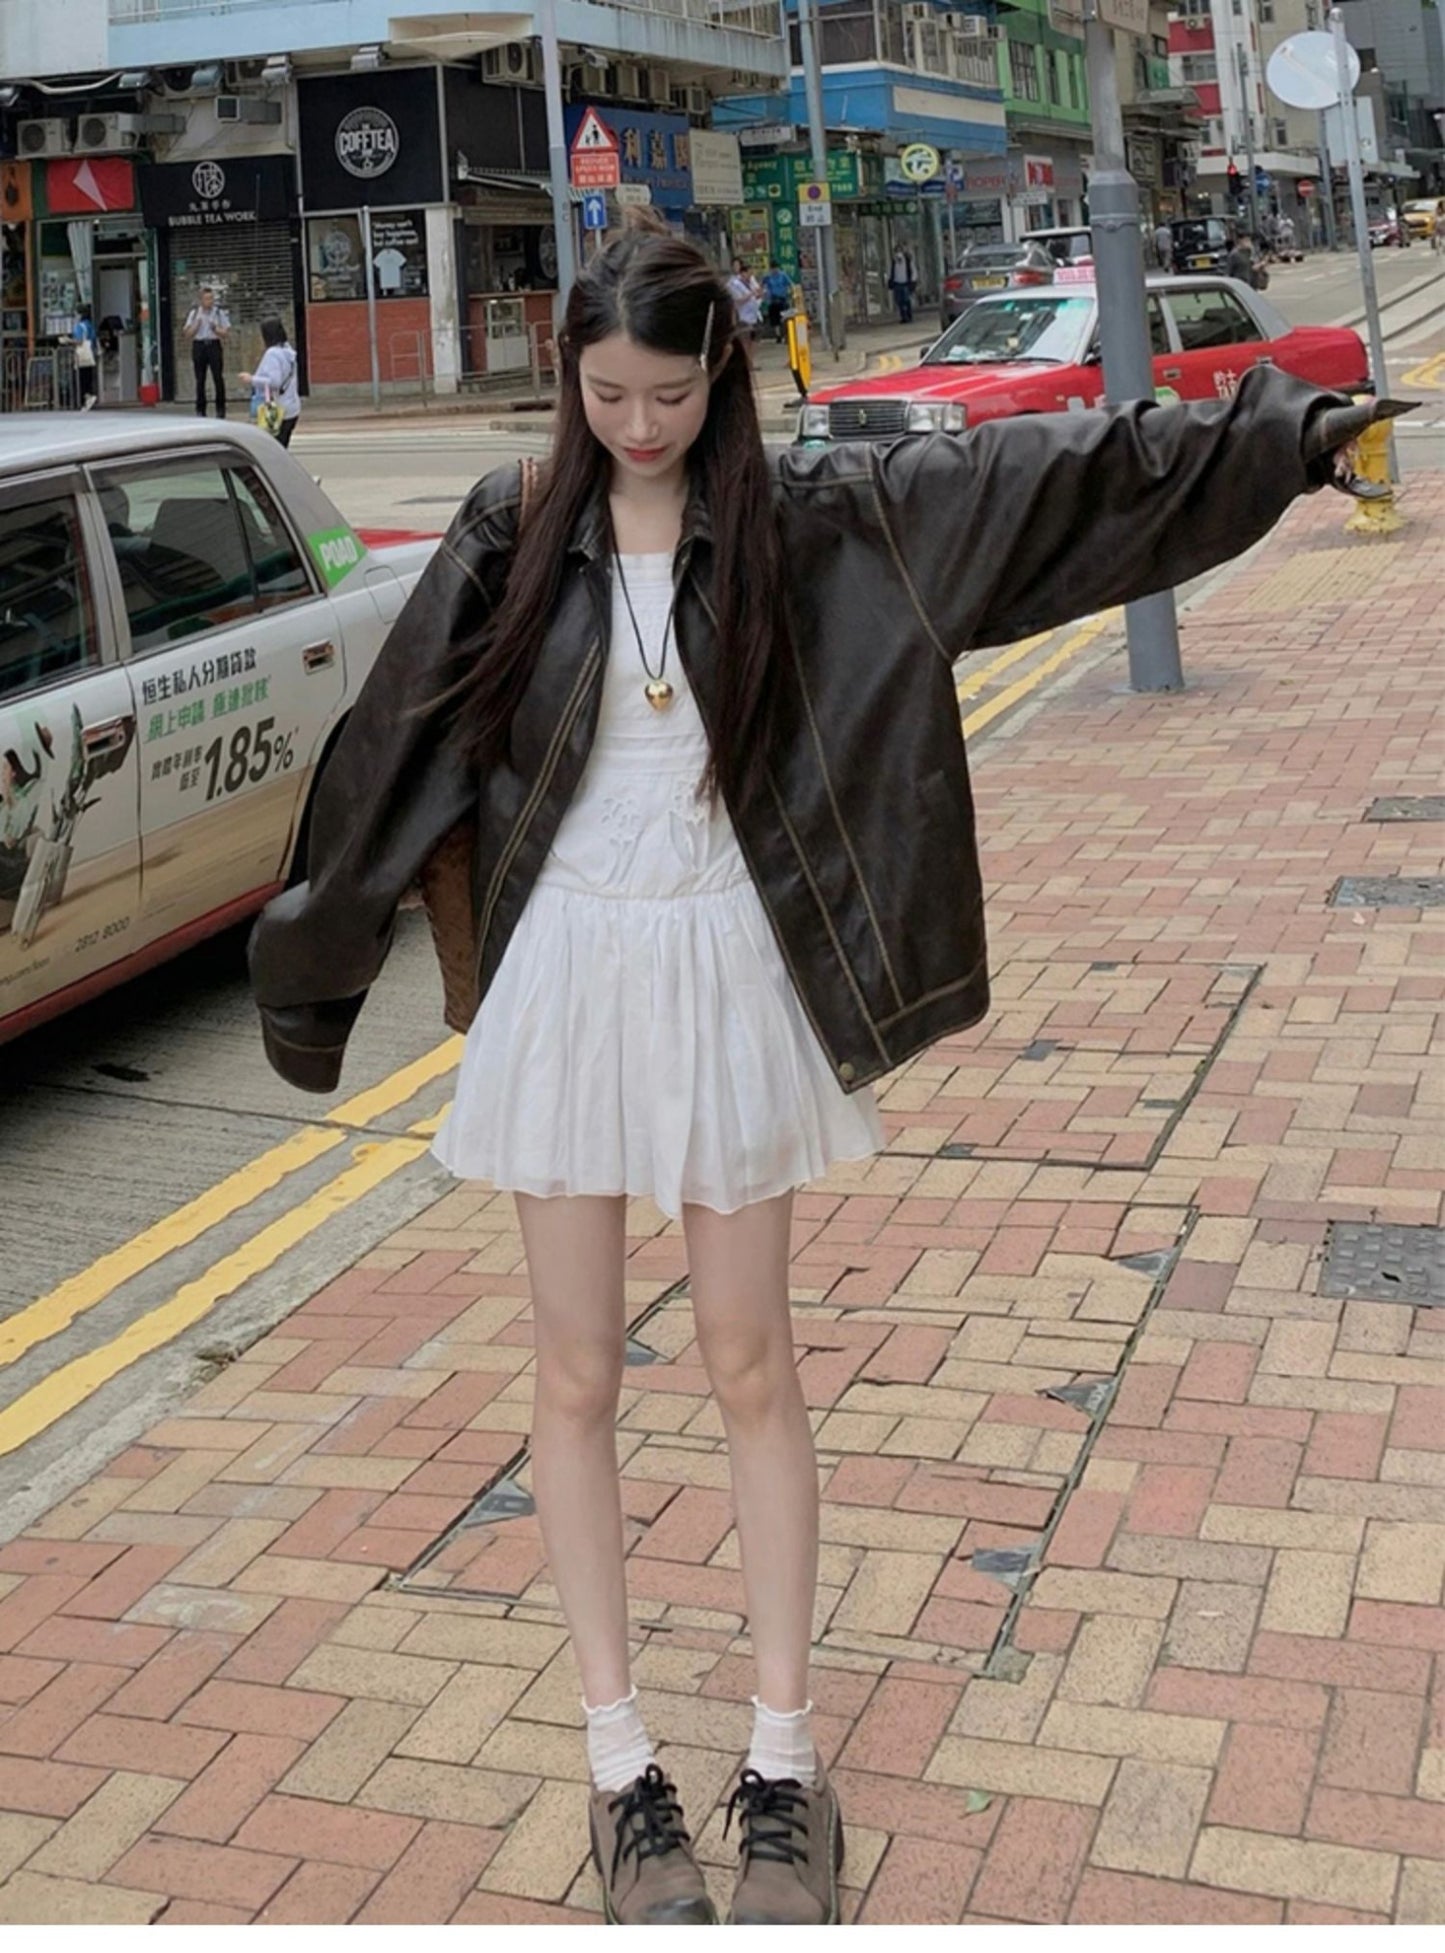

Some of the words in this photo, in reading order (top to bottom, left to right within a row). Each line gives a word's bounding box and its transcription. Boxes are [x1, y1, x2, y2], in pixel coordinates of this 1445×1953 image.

[168, 215, 202, 227] BUBBLE
[204, 213, 223, 224] TEA
[319, 536, 357, 571] POAD
